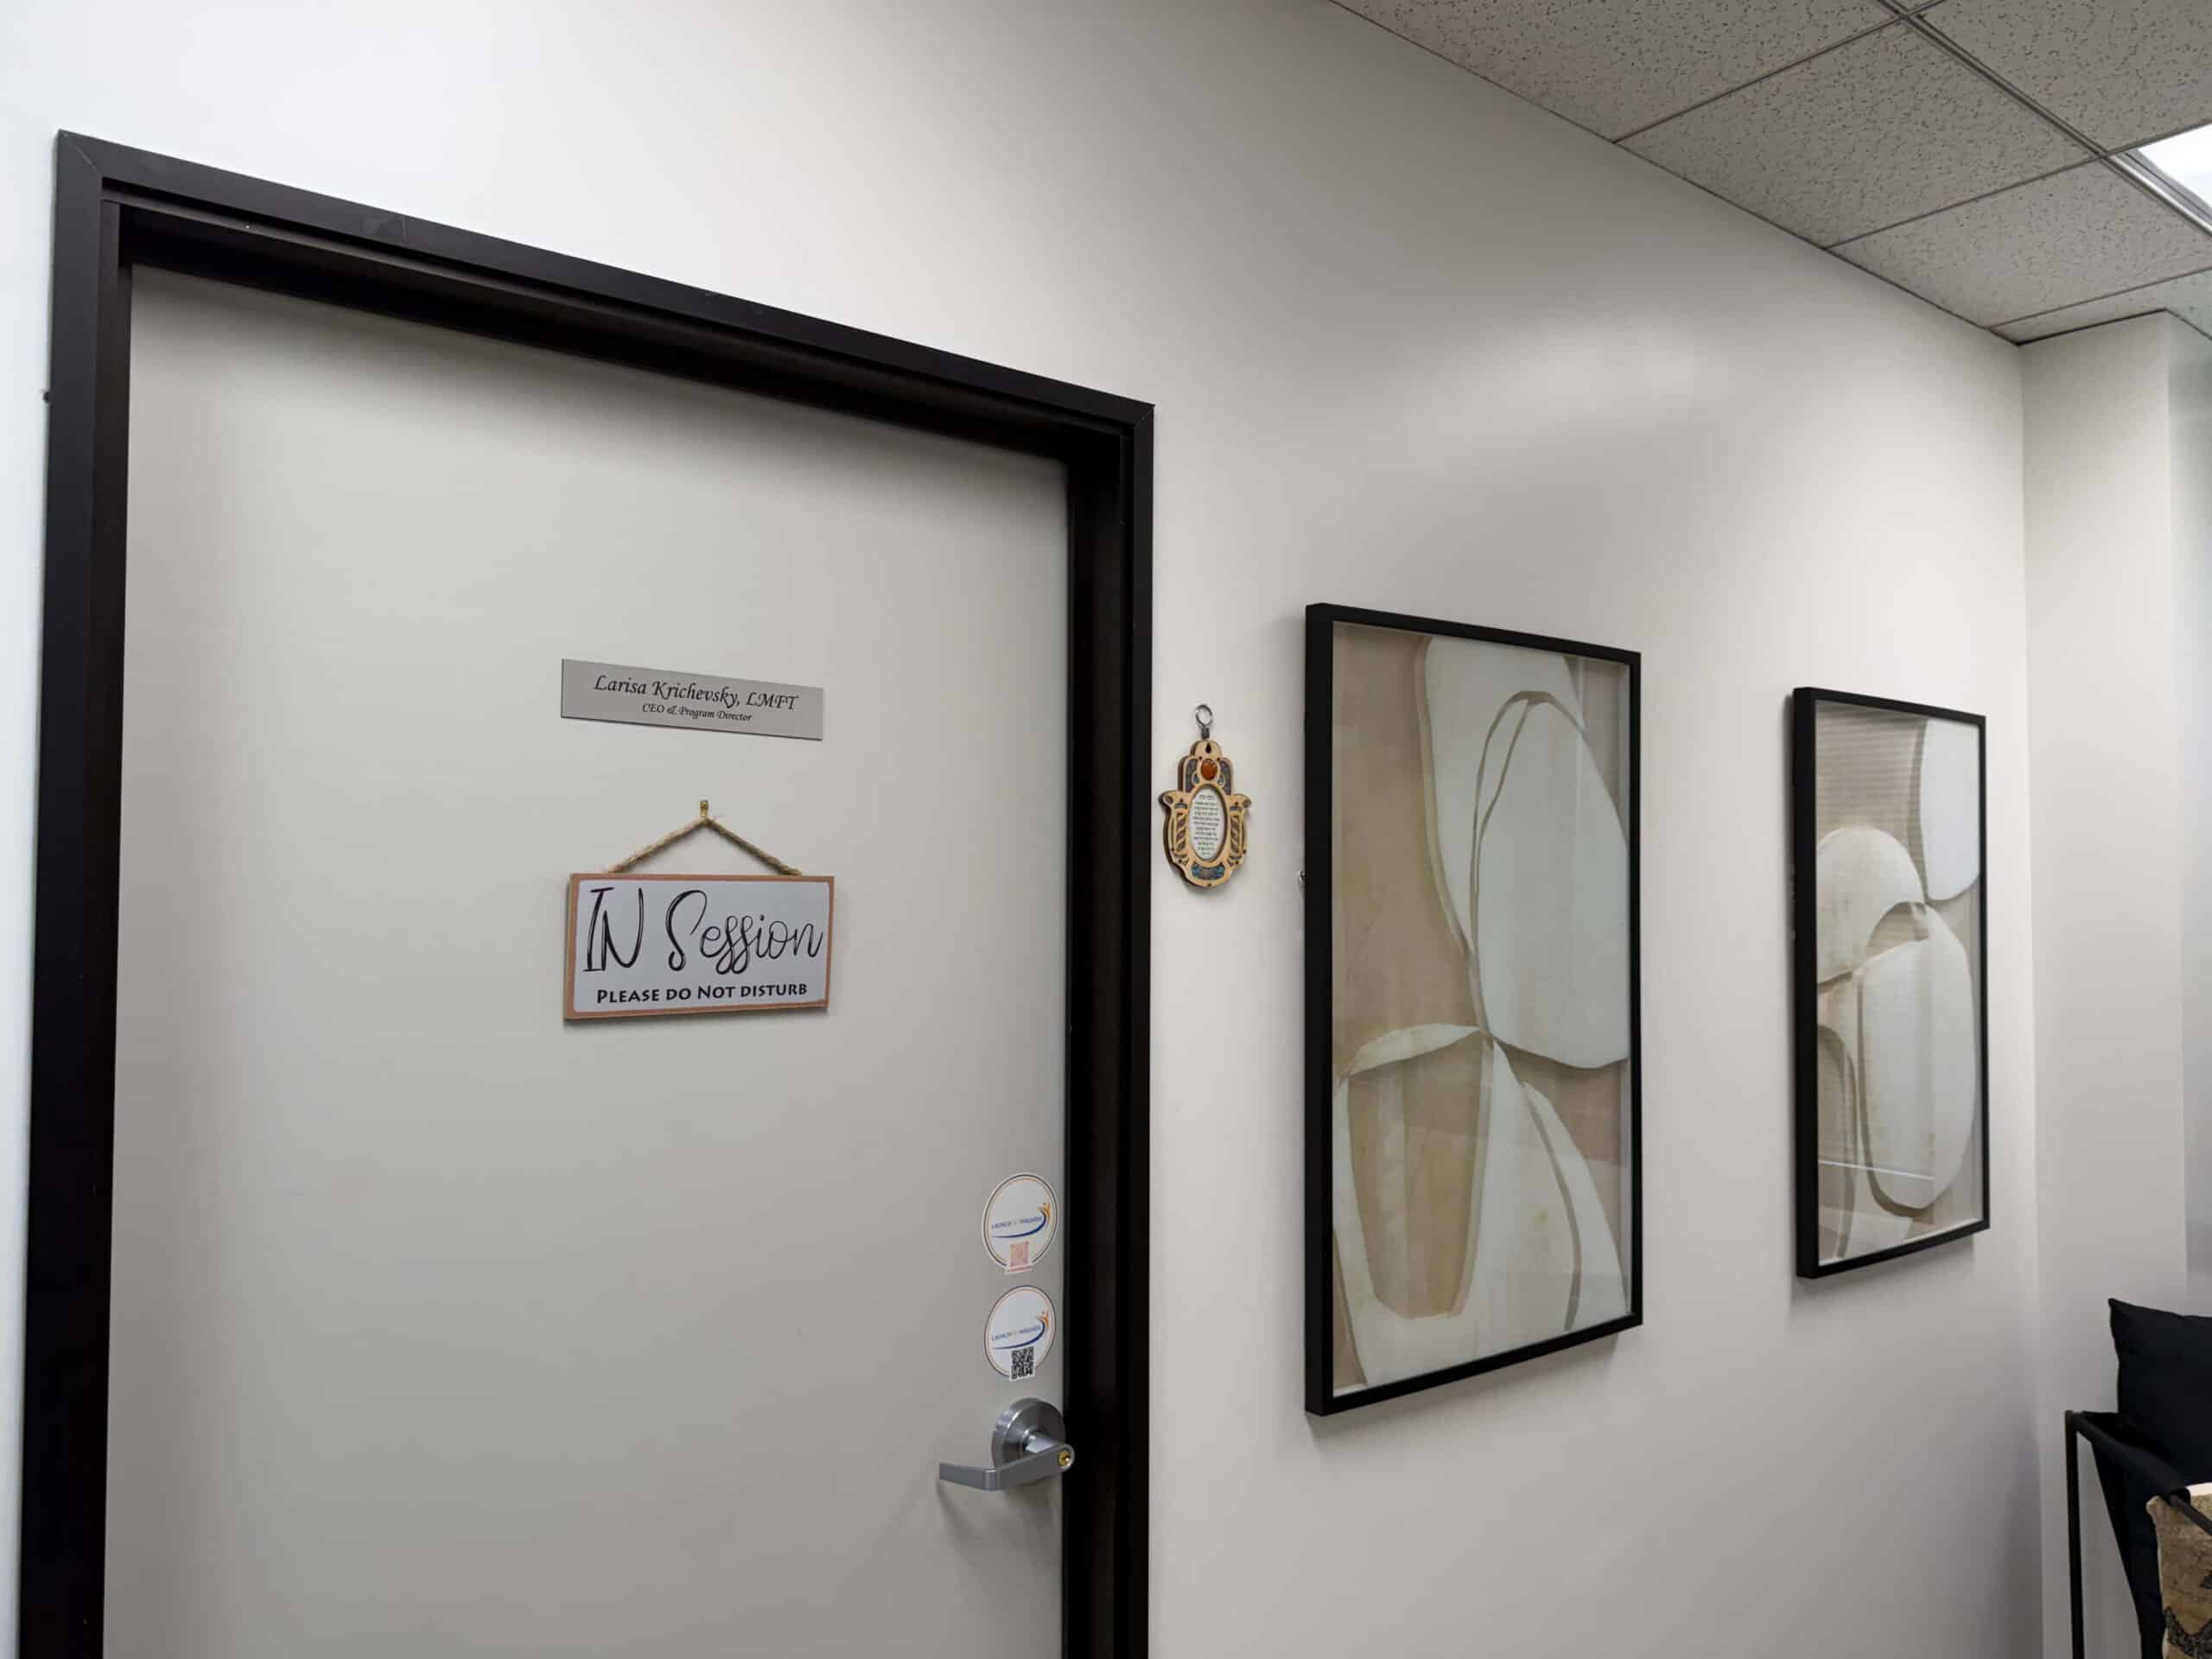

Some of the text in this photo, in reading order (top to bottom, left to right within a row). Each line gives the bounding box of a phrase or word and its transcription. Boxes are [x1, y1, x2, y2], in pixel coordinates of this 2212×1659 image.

[594, 675, 799, 710] Larisa Krichevsky, LMFT
[642, 703, 753, 721] CEO & Program Director
[582, 887, 823, 975] IN Session
[597, 983, 807, 1003] PLEASE DO NOT DISTURB
